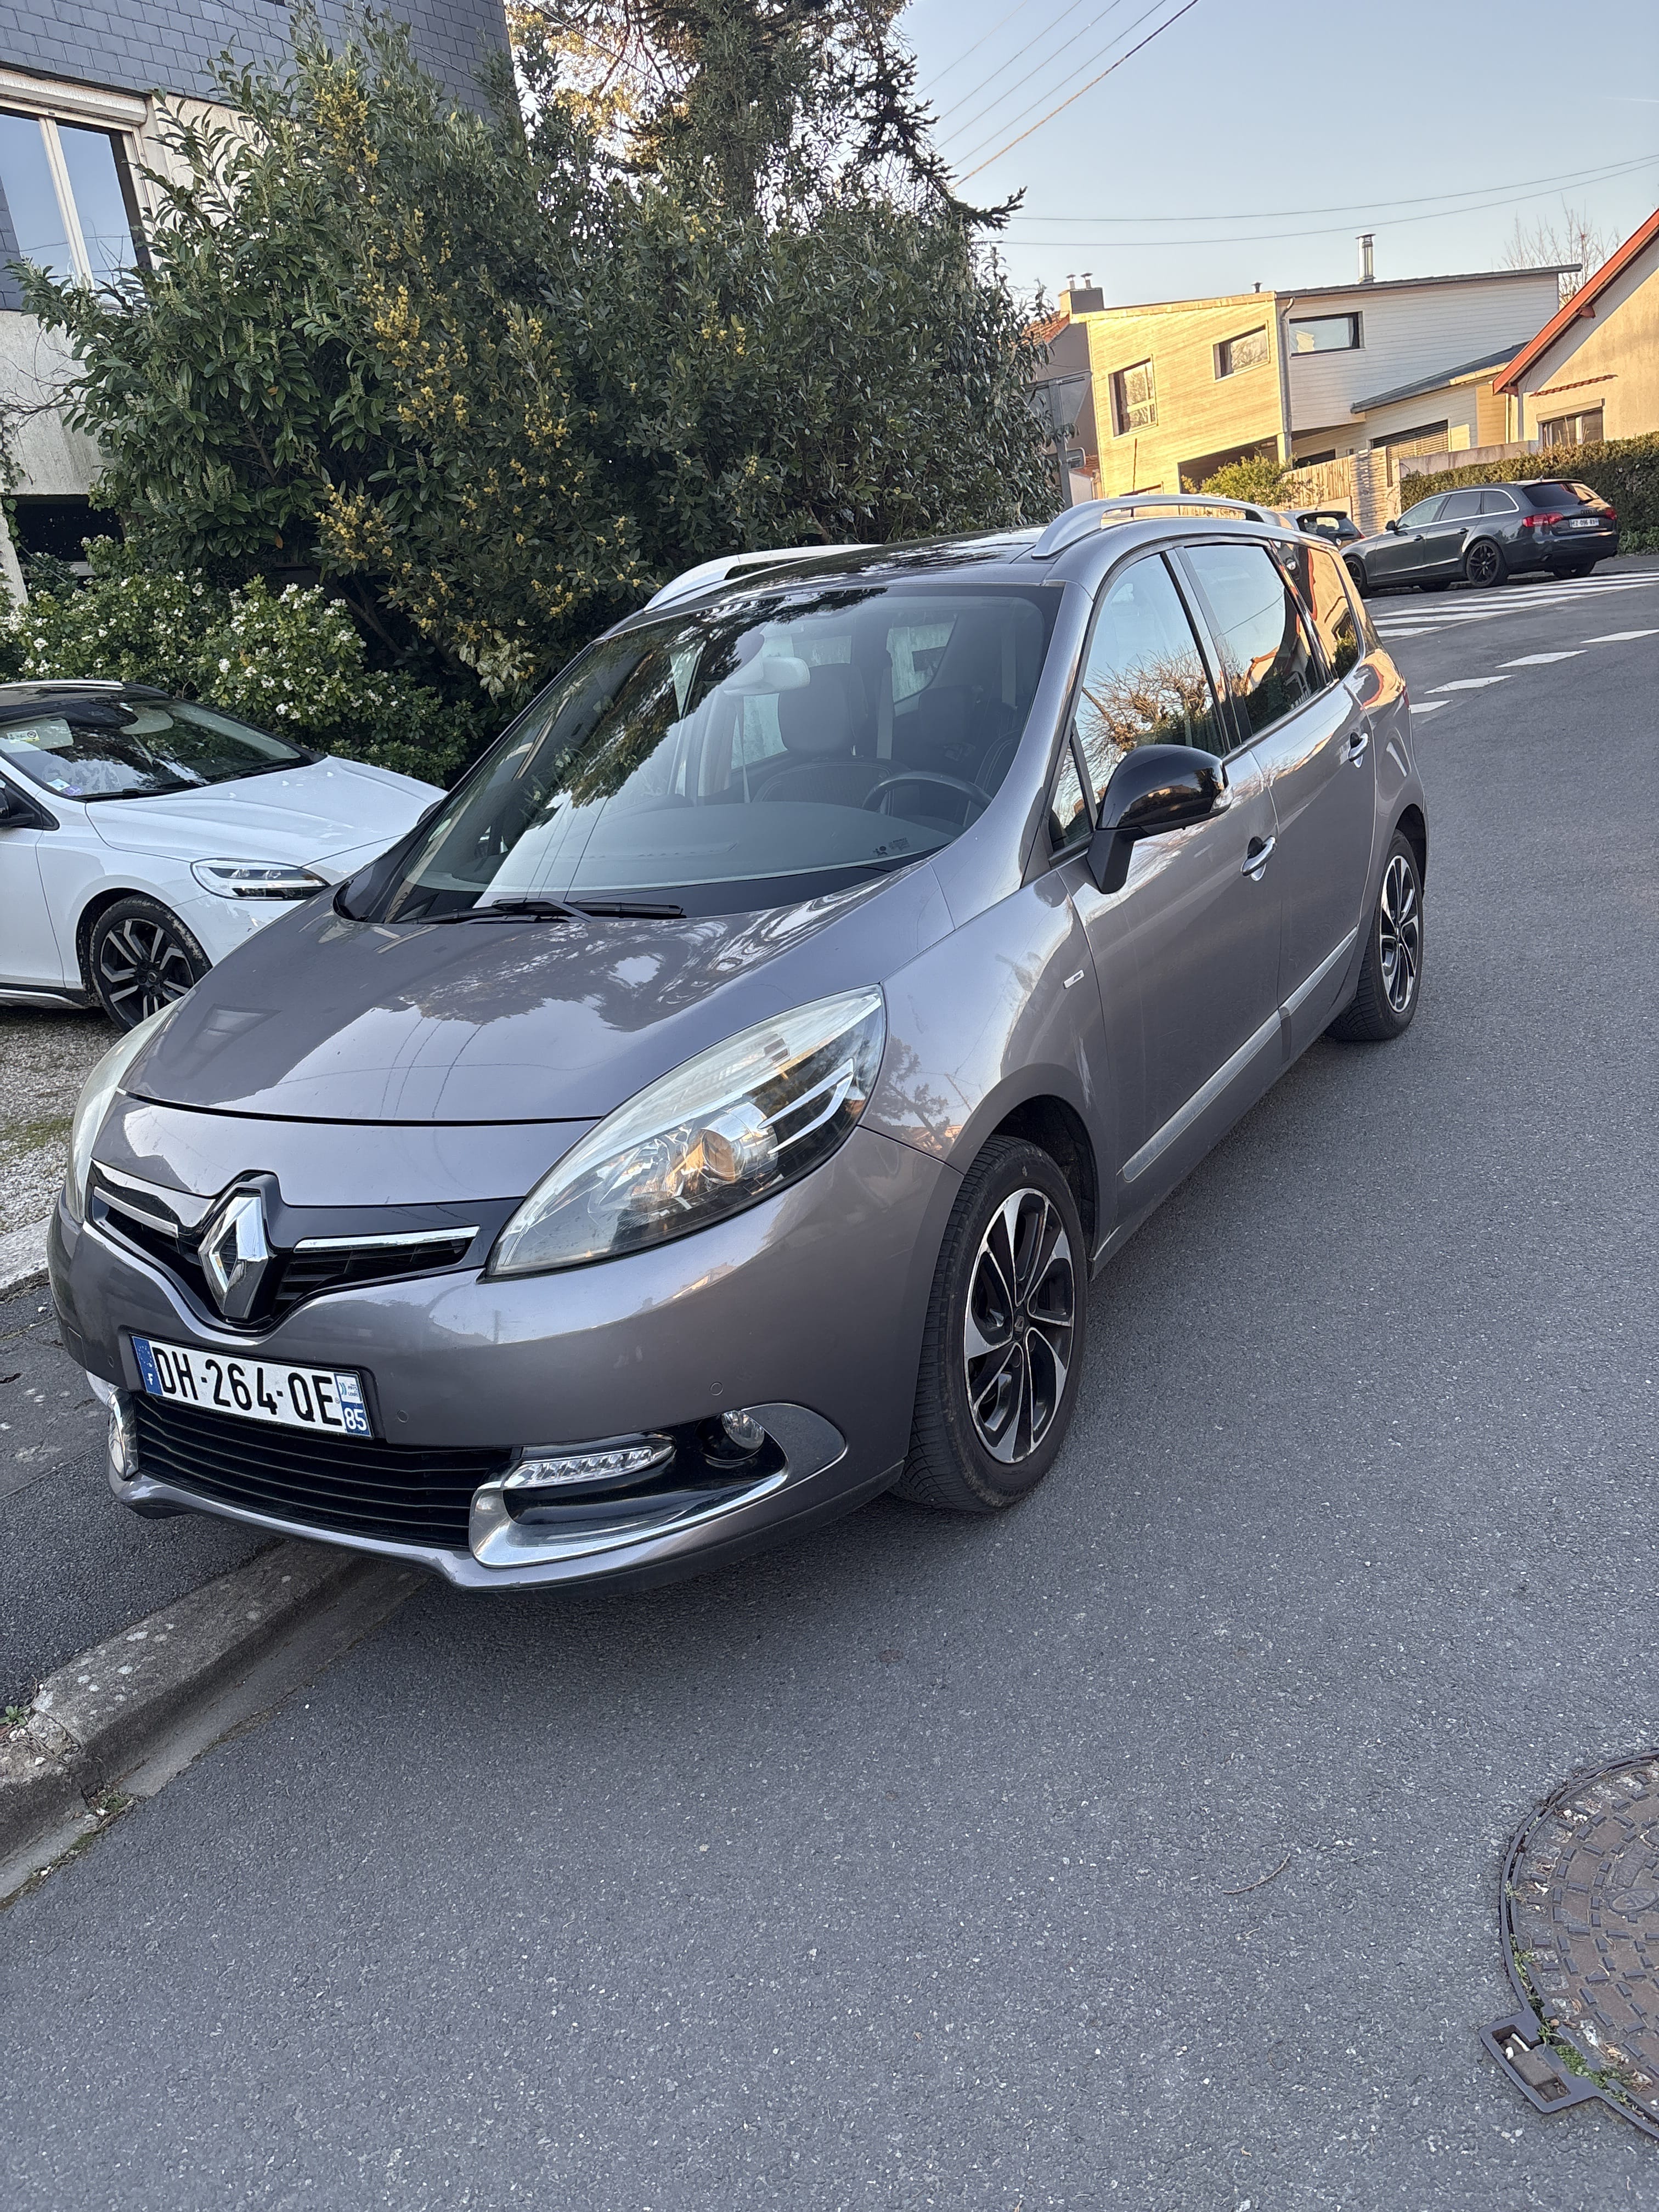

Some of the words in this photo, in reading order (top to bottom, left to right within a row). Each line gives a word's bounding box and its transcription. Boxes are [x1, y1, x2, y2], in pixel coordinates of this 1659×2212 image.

[147, 1373, 153, 1386] F
[151, 1346, 342, 1426] DH-264-QE
[344, 1407, 367, 1431] 85
